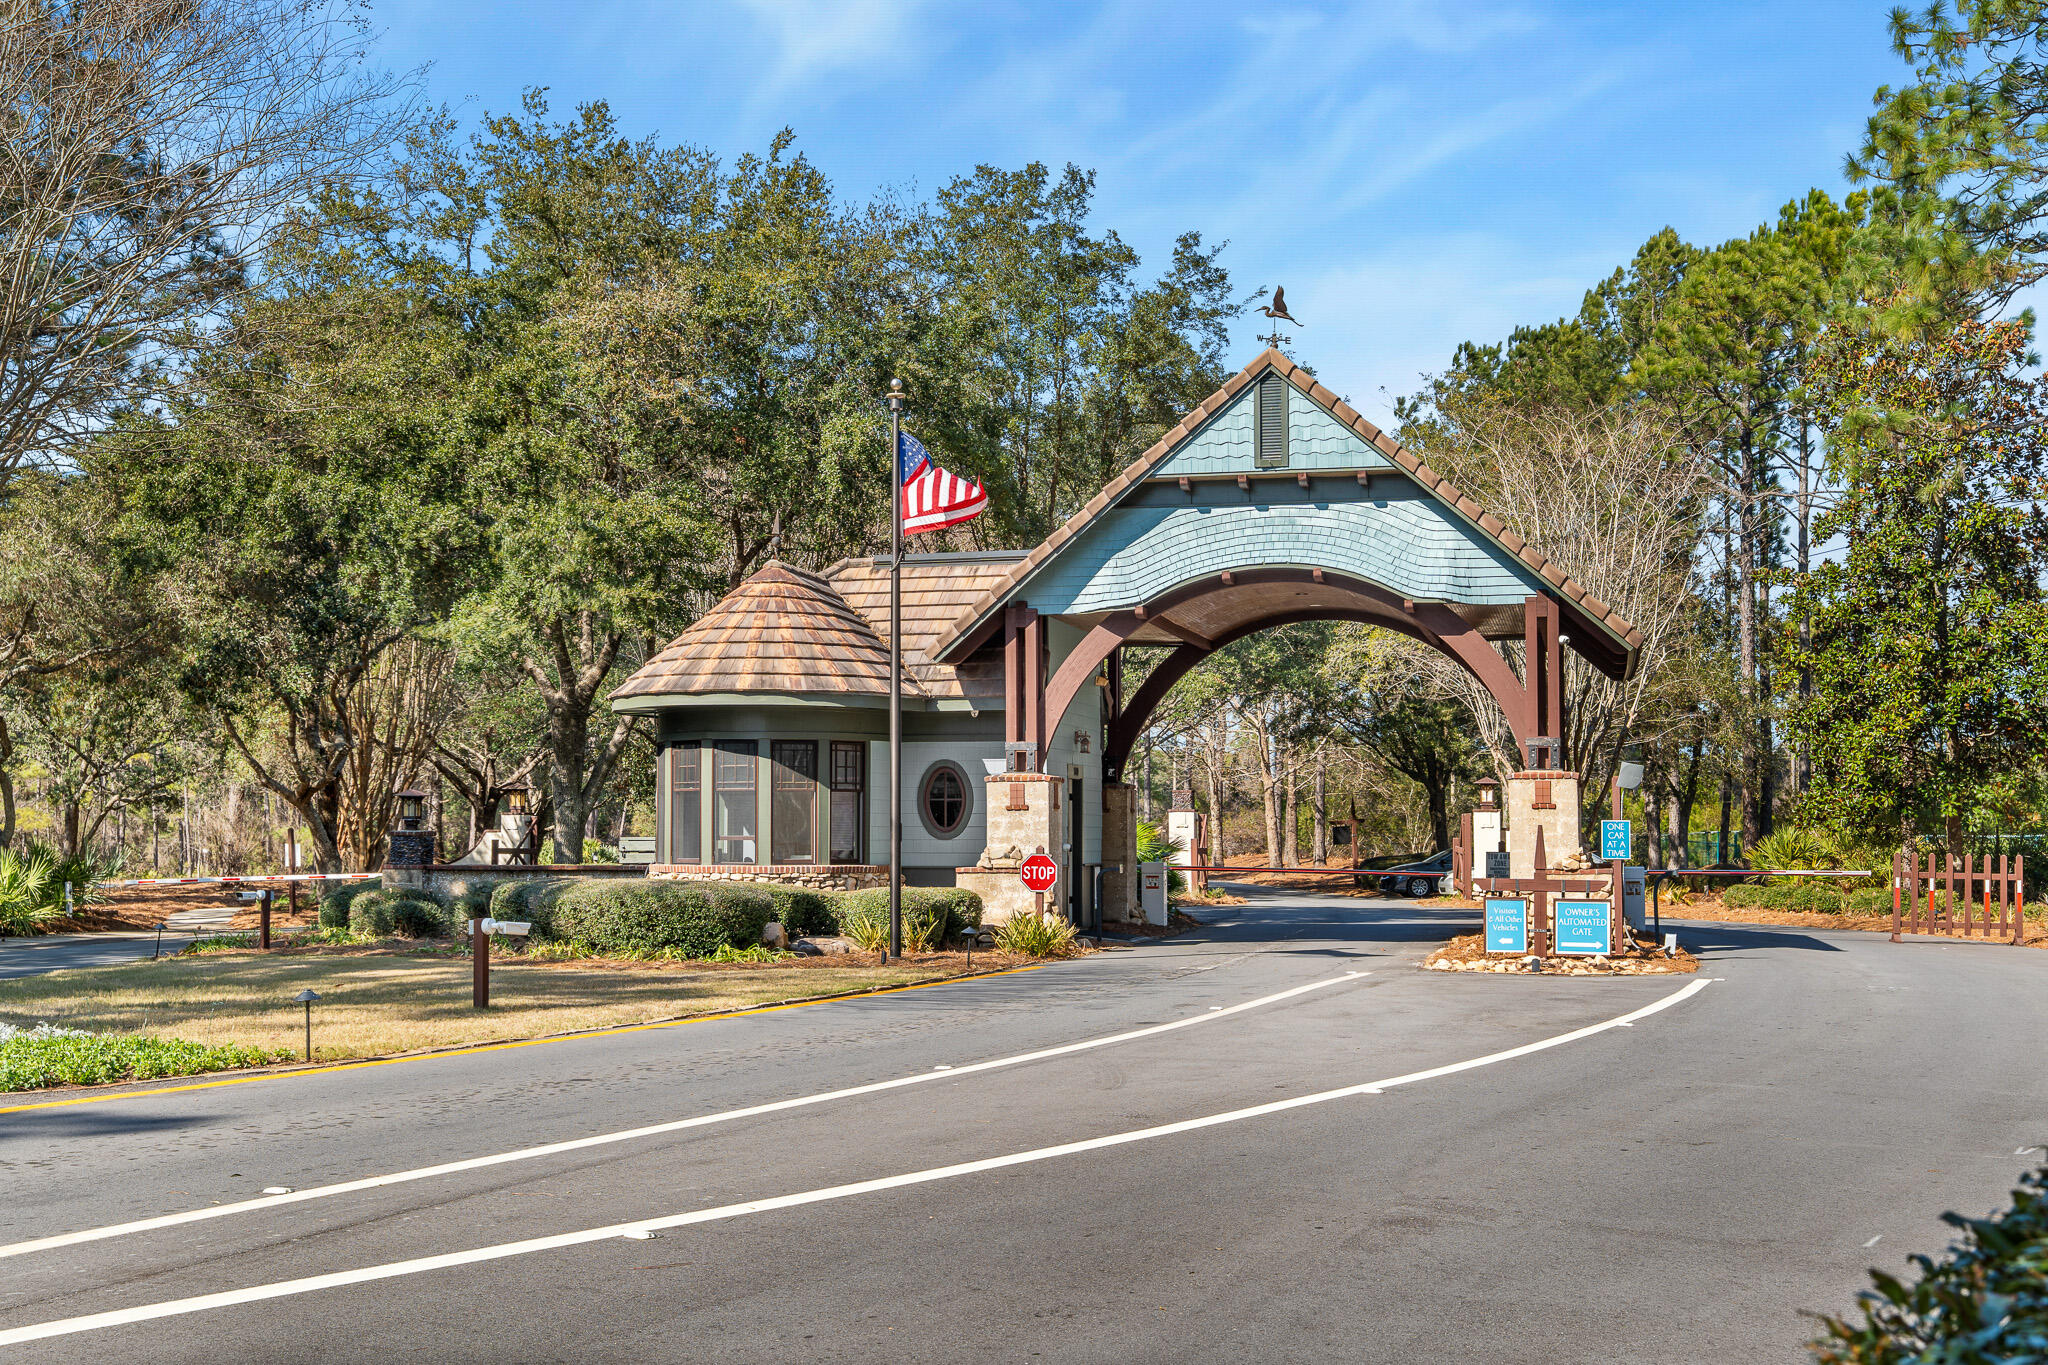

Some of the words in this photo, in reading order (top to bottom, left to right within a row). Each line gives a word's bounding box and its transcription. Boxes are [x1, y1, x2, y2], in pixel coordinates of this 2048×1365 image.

[1608, 831, 1625, 839] CAR
[1607, 840, 1617, 848] AT
[1607, 849, 1626, 857] TIME
[1023, 865, 1055, 880] STOP
[1565, 908, 1600, 916] OWNER'S
[1558, 918, 1607, 926] AUTOMATED
[1572, 928, 1593, 936] GATE
